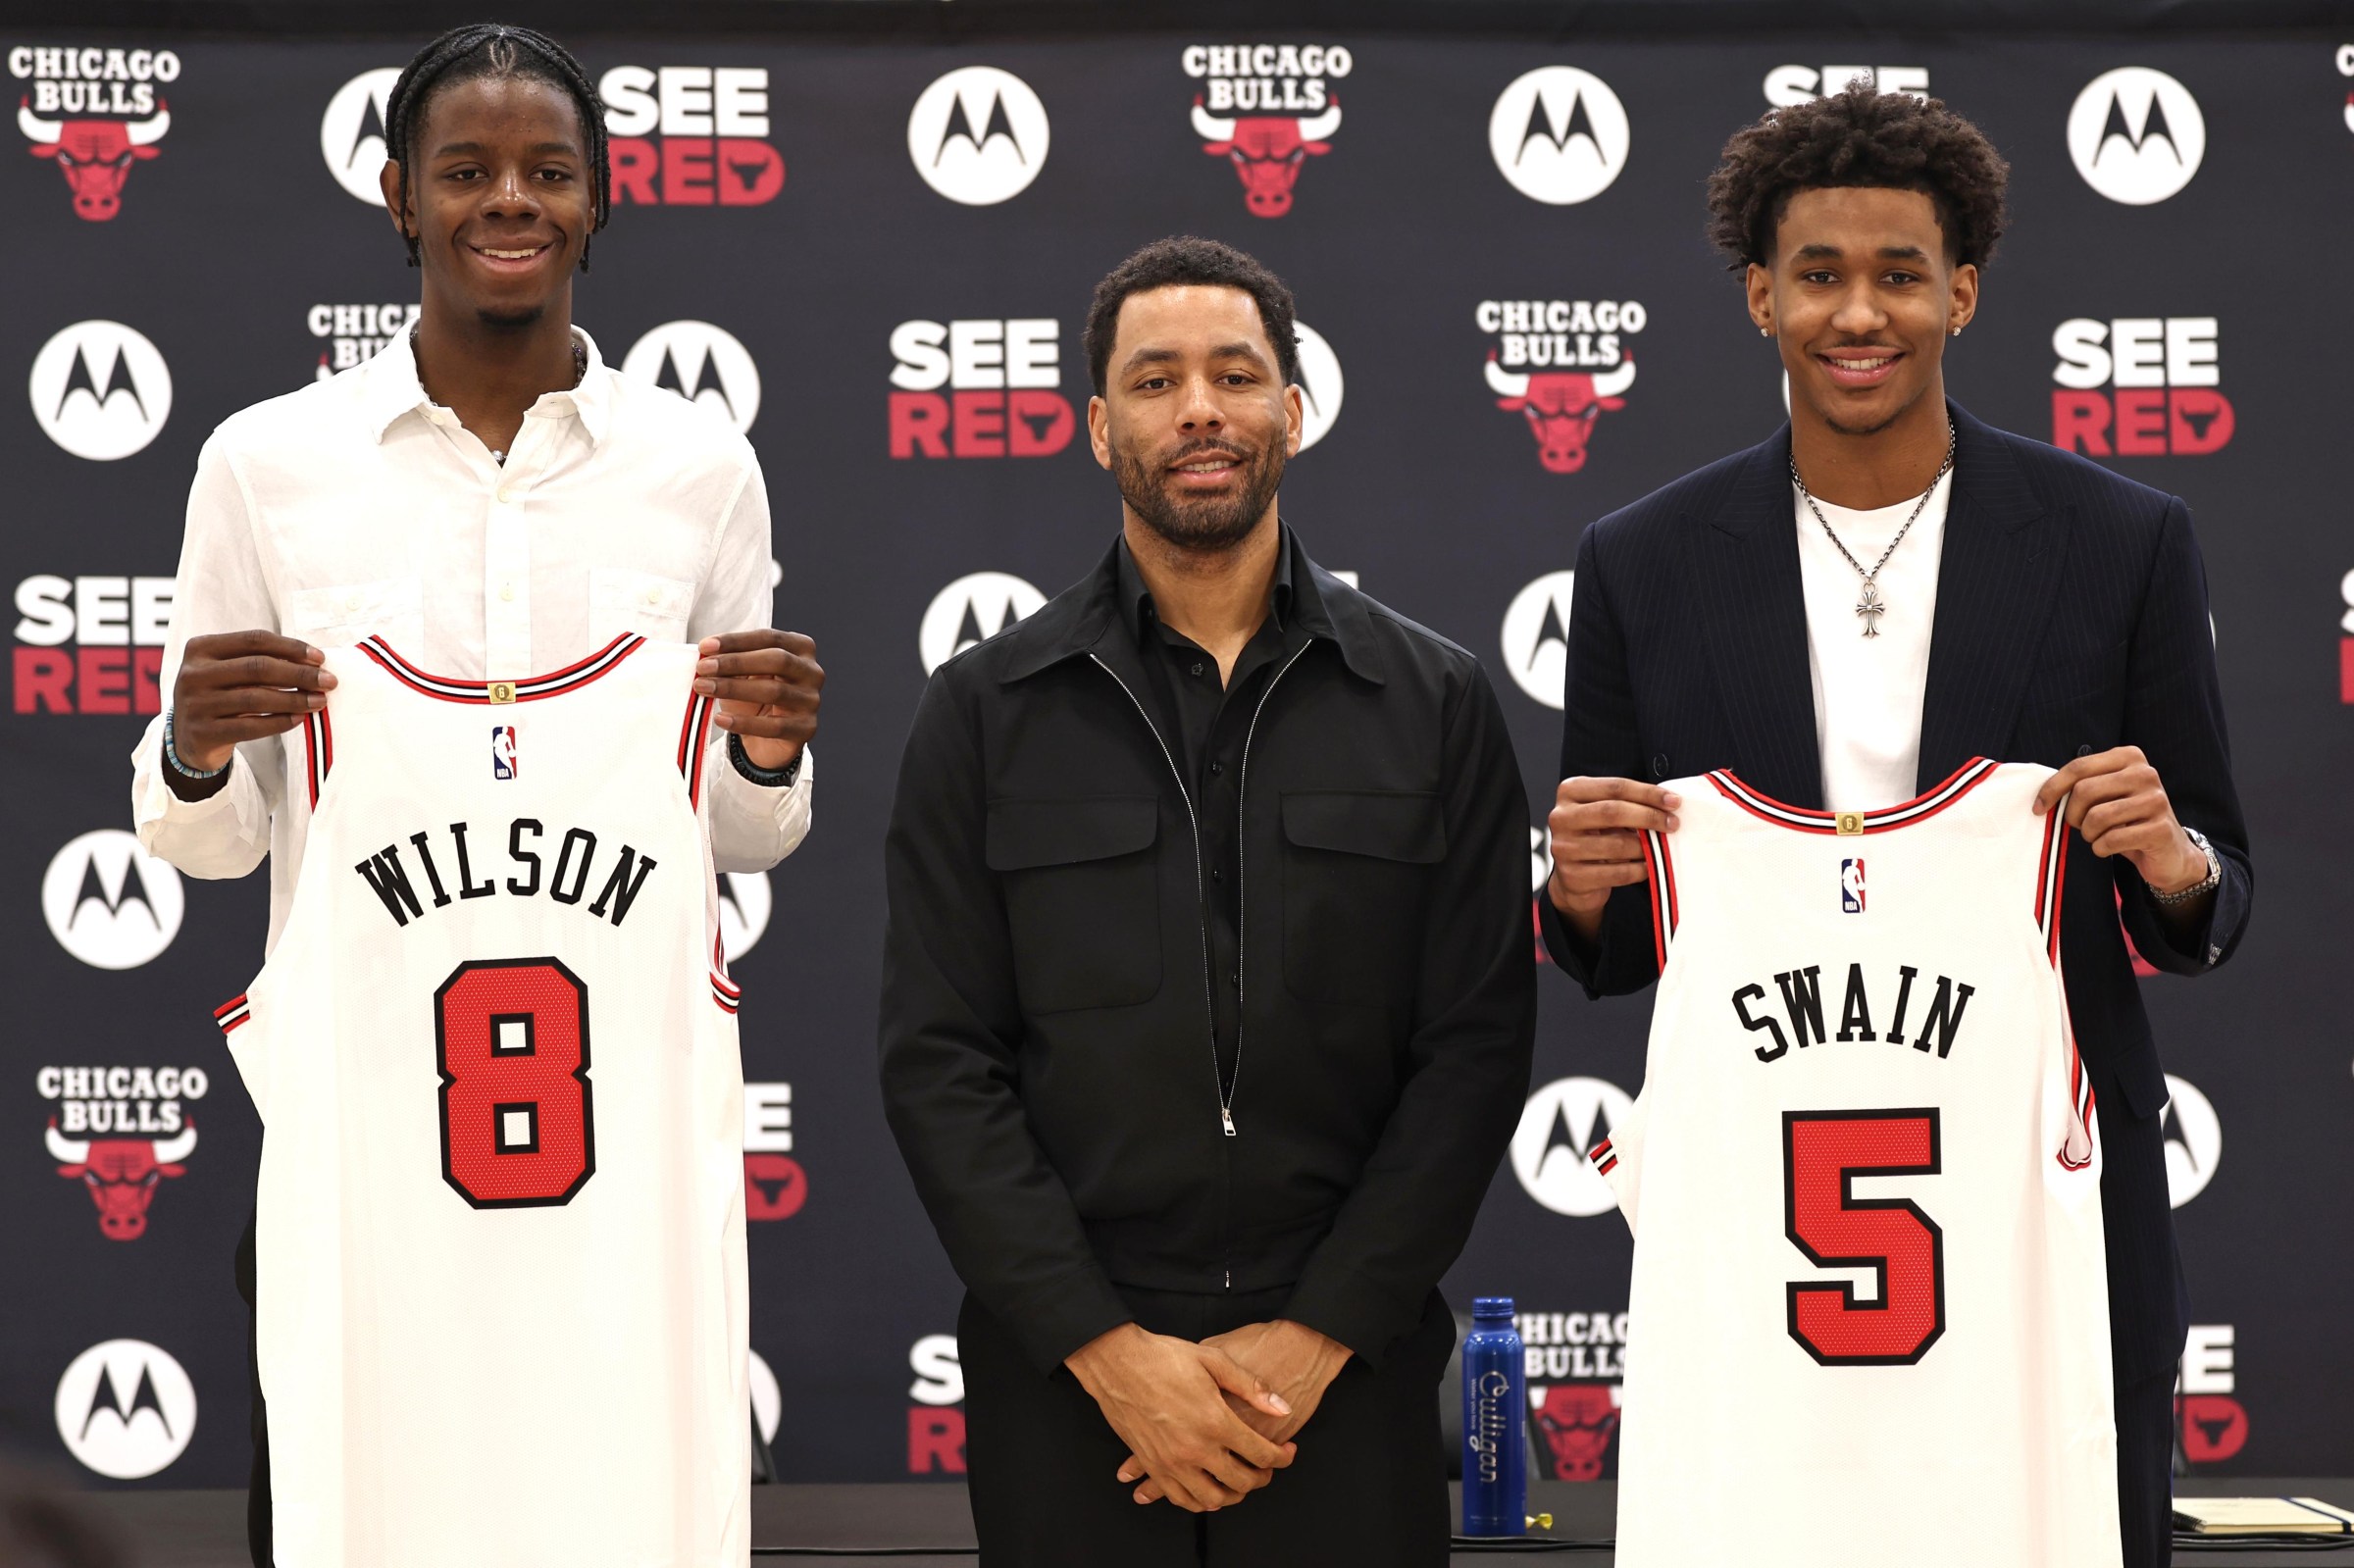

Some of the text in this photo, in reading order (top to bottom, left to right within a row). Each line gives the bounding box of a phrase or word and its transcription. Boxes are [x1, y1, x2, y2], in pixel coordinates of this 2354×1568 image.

[9, 47, 180, 82] CHICAGO
[1183, 45, 1353, 77] CHICAGO
[1208, 78, 1326, 111] BULLS
[35, 80, 155, 116] BULLS
[599, 66, 770, 136] SEE
[608, 135, 786, 207] RED
[308, 303, 421, 337] CHIC
[1476, 300, 1646, 335] CHICAGO
[1502, 332, 1620, 366] BULLS
[890, 319, 1060, 390] SEE
[2053, 317, 2220, 388] SEE
[889, 390, 1076, 459] RED
[2052, 389, 2235, 456] RED
[14, 575, 177, 646] SEE
[355, 819, 657, 927] WILSON
[1845, 901, 1858, 911] NBA
[1732, 963, 1975, 1063] SWAIN
[37, 1067, 208, 1099] CHICAGO
[62, 1099, 182, 1133] BULLS
[434, 956, 596, 1210] 8
[1782, 1107, 1946, 1366] 5
[1469, 1371, 1509, 1483] Culligan
